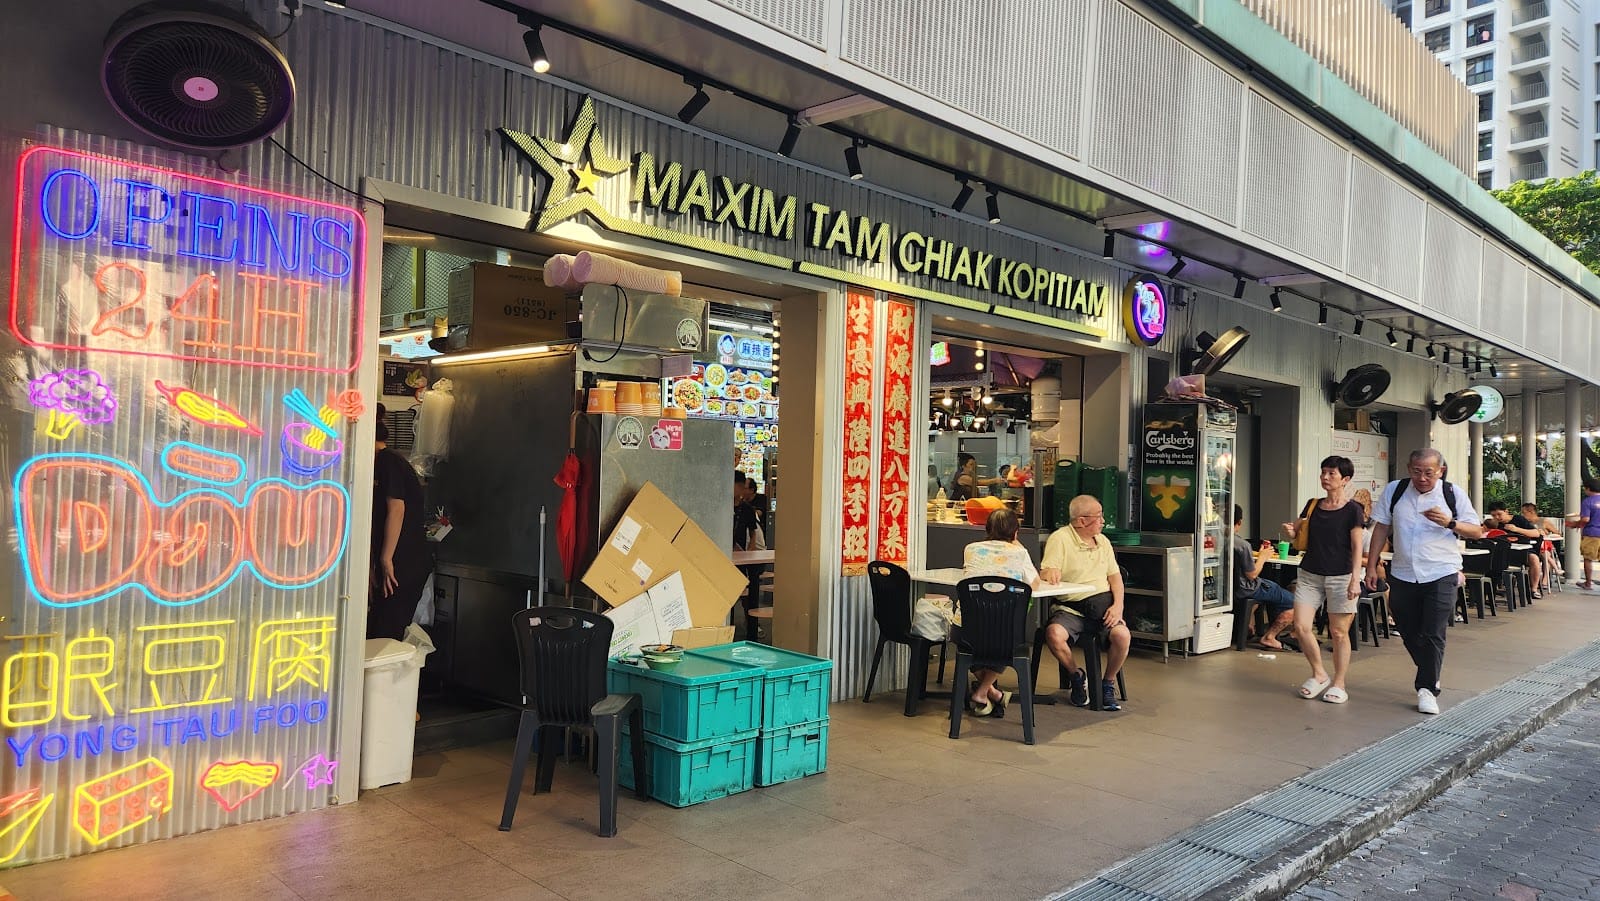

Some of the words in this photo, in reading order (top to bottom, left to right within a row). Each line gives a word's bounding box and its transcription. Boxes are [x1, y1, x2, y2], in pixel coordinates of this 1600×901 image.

[40, 168, 354, 280] OPENS
[632, 152, 797, 240] MAXIM
[808, 202, 890, 263] TAM
[898, 231, 994, 290] CHIAK
[998, 258, 1108, 317] KOPITIAM
[91, 262, 323, 358] 24H
[1145, 430, 1195, 451] Carlsberg
[1146, 452, 1171, 460] Probably
[1, 617, 337, 728] 酿豆腐
[7, 724, 139, 768] YONG
[153, 708, 237, 746] TAU
[253, 699, 328, 734] FOO
